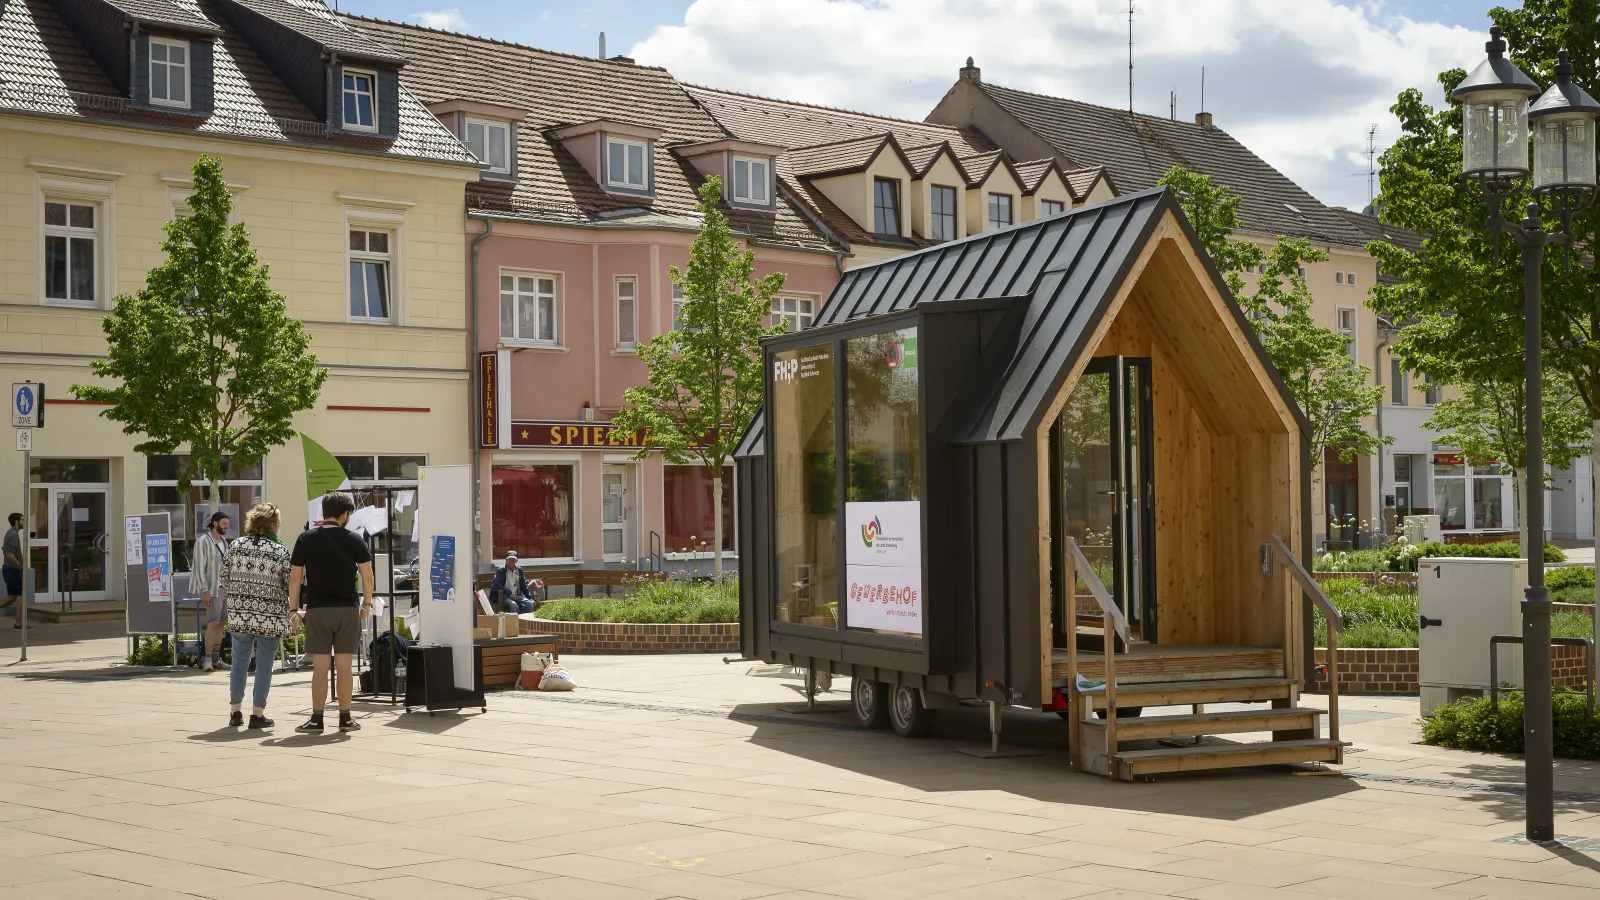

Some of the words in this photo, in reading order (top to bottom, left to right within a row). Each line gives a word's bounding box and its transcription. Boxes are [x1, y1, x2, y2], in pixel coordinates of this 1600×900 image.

[18, 416, 31, 424] ZONE
[1433, 565, 1441, 579] 1
[850, 581, 918, 606] GEWERBEHOF
